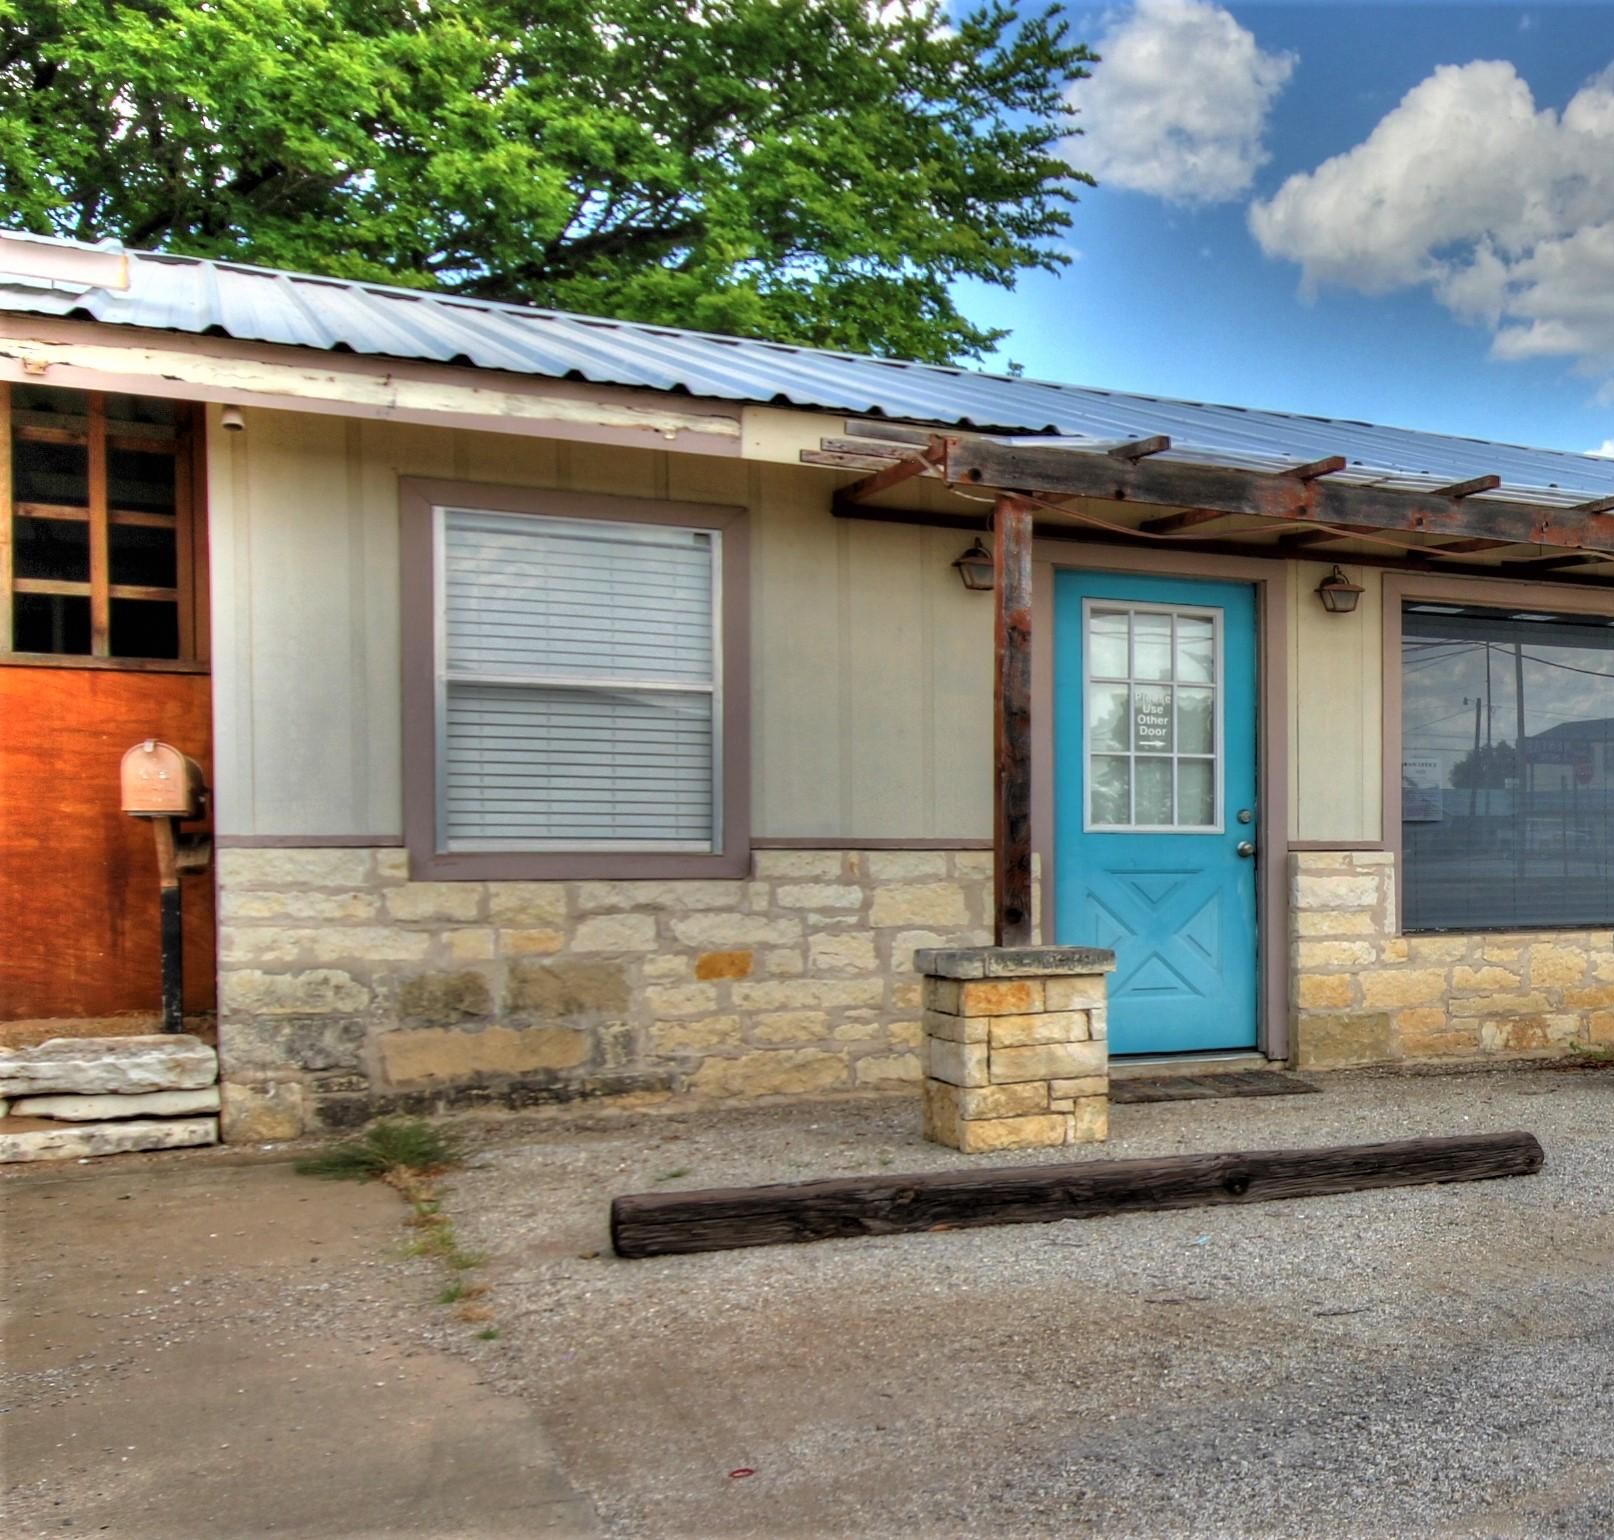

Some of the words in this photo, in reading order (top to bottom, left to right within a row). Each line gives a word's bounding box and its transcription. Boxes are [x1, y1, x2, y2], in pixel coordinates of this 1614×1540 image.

[1142, 704, 1164, 714] Use
[1137, 714, 1169, 725] Other
[1139, 726, 1167, 736] Door
